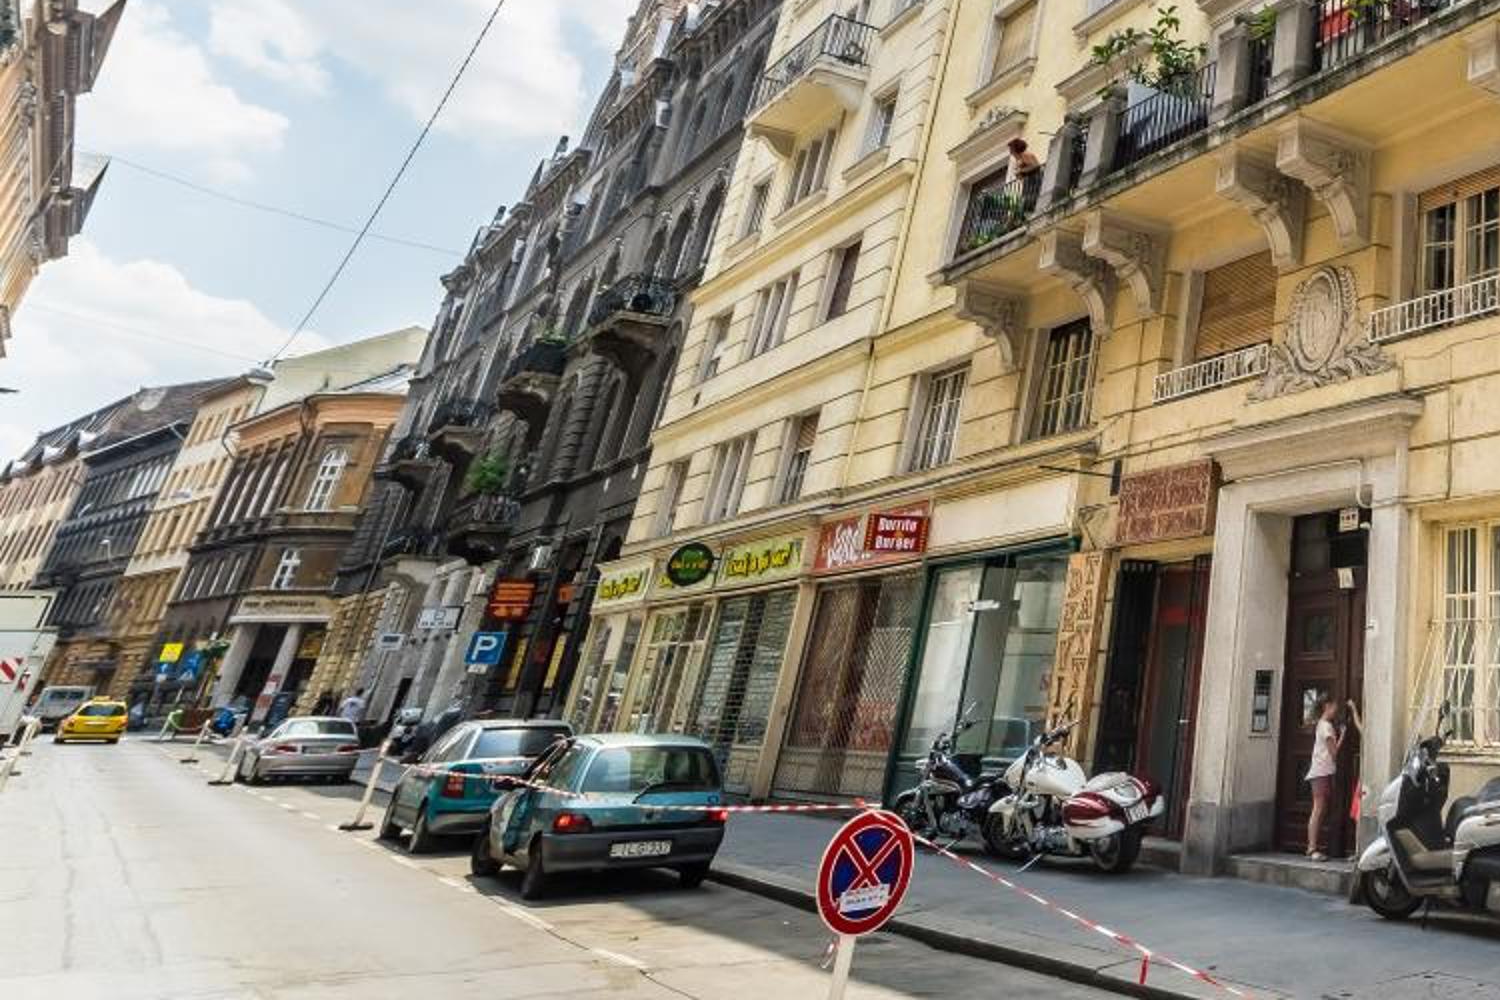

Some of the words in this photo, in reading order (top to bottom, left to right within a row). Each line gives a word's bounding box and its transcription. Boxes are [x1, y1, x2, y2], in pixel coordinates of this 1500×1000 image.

[877, 517, 918, 533] Burrito
[875, 535, 917, 551] Burger
[471, 635, 498, 661] P
